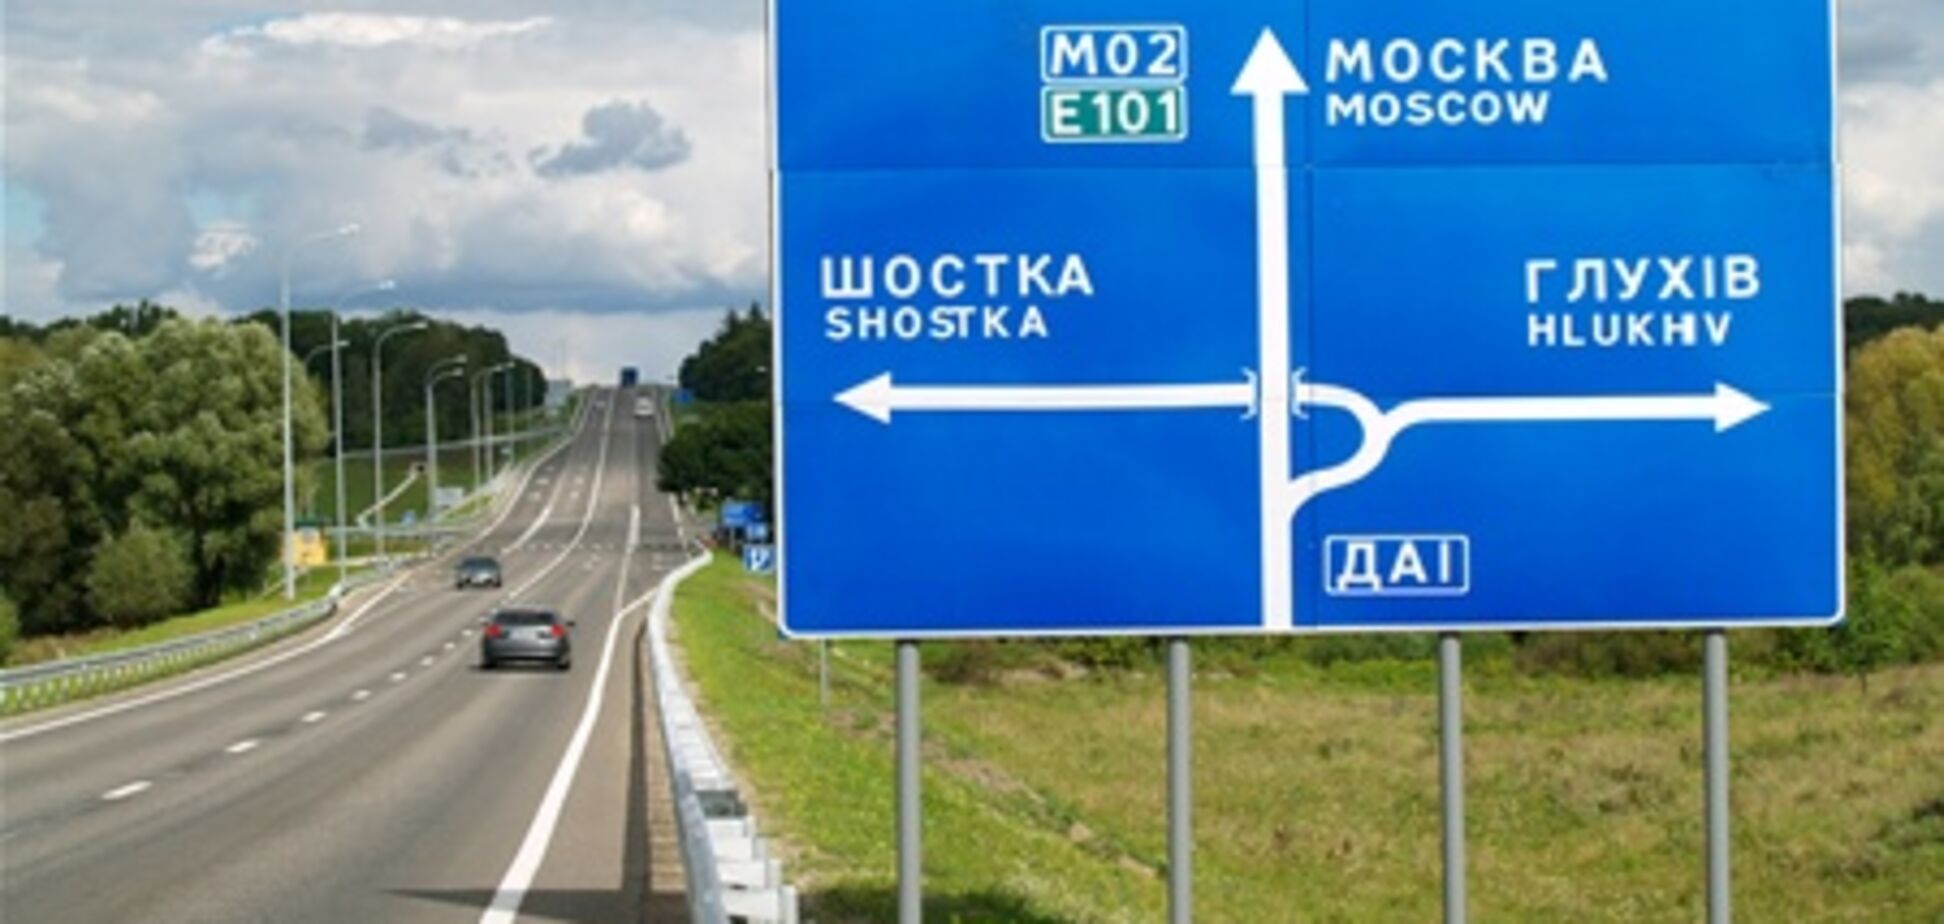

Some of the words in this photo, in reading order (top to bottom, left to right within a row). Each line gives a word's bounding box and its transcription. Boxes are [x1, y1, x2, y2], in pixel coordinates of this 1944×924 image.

[1050, 32, 1178, 76] M02
[1326, 39, 1607, 82] МОСКВА
[1051, 90, 1178, 135] E101
[1327, 91, 1549, 126] MOSCOW
[822, 255, 1093, 298] ШОСТКА
[1525, 255, 1760, 302] ГЛУХІВ
[825, 306, 1048, 340] SHOSTKA
[1337, 541, 1450, 590] ДАІ
